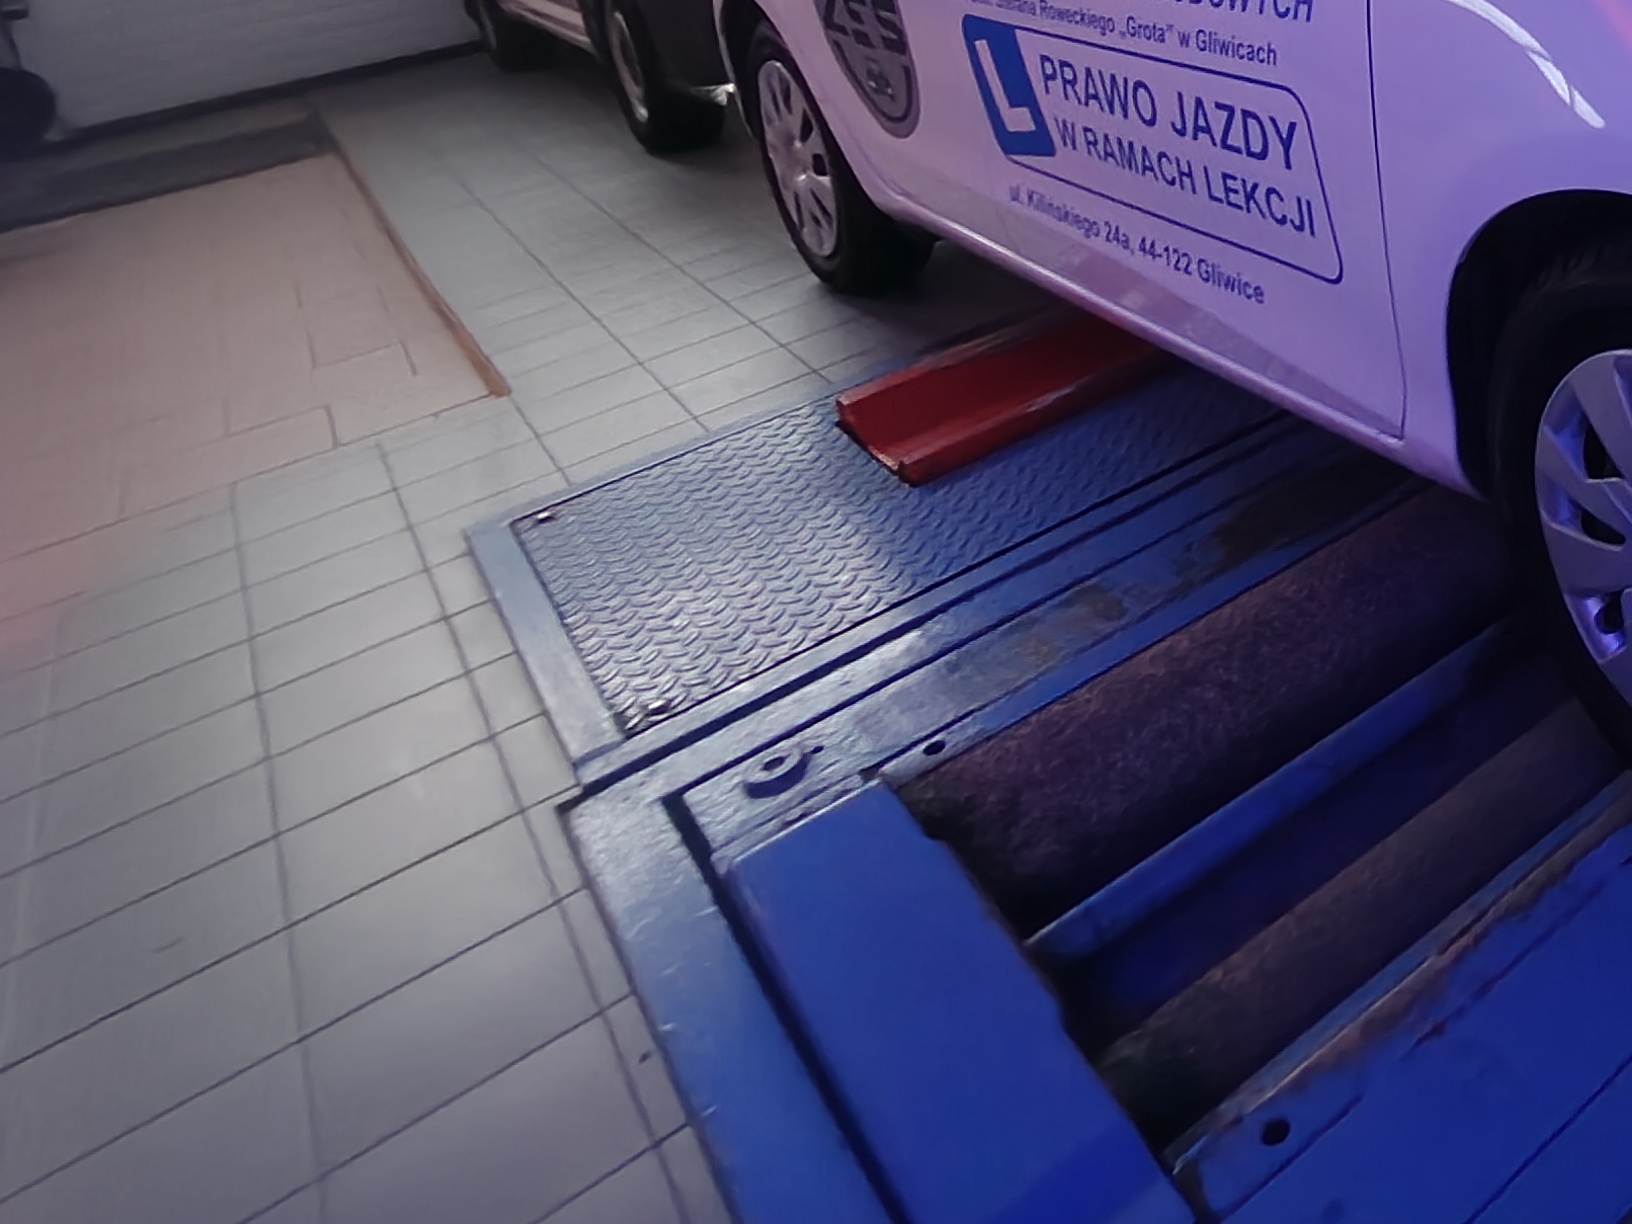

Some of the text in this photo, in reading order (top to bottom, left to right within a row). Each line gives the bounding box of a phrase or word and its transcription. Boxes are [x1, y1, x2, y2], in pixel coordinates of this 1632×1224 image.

[973, 38, 1037, 133] L
[1178, 30, 1191, 48] w
[1196, 28, 1278, 66] Gliwicach
[1039, 53, 1298, 171] PRAWO JAZDY
[1053, 116, 1316, 239] W RAMACH LEKCJI
[1103, 221, 1135, 256] 24a,
[1138, 235, 1192, 276] 44-122
[1197, 258, 1265, 305] Gliwice
